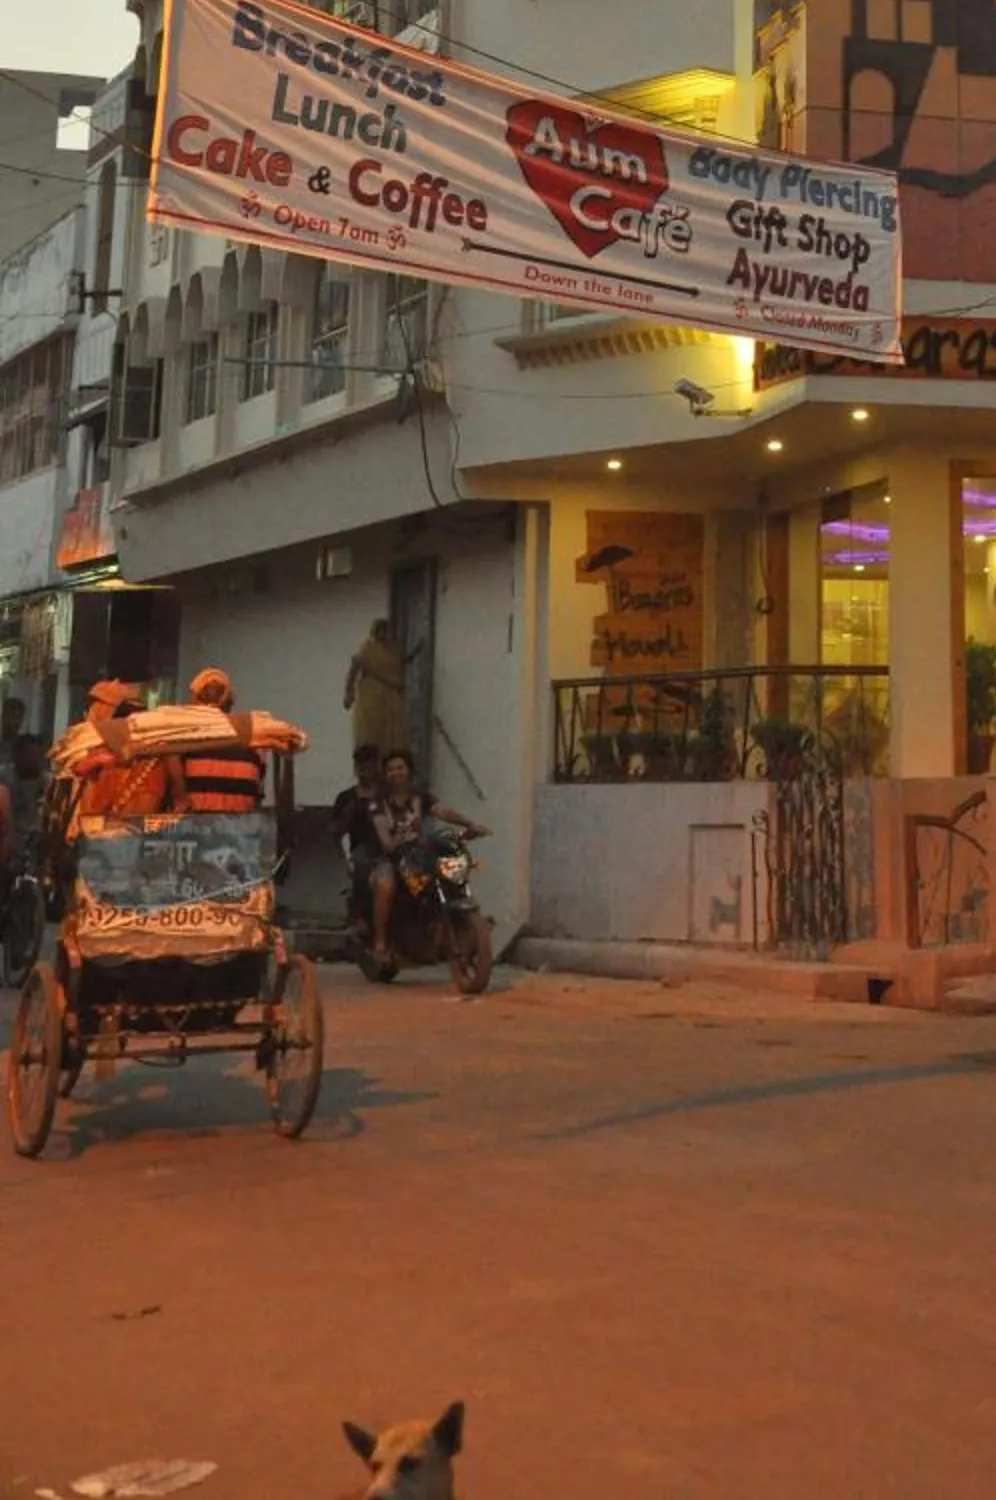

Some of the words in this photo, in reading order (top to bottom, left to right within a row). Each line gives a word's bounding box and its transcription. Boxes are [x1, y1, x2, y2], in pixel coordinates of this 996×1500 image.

[232, 1, 446, 106] Breakfast
[272, 74, 408, 153] Lunch
[167, 115, 293, 187] Cake
[307, 166, 331, 195] &
[348, 159, 488, 232] Coffee
[527, 117, 648, 183] Aum
[274, 204, 330, 234] Open
[338, 217, 379, 246] 7am
[688, 146, 770, 200] Body
[780, 162, 897, 233] Piercing
[726, 200, 788, 253] Gift
[799, 215, 870, 272] Shop
[525, 265, 578, 289] Down
[584, 273, 611, 297] the
[619, 281, 654, 303] lane
[727, 248, 870, 311] Ayurveda
